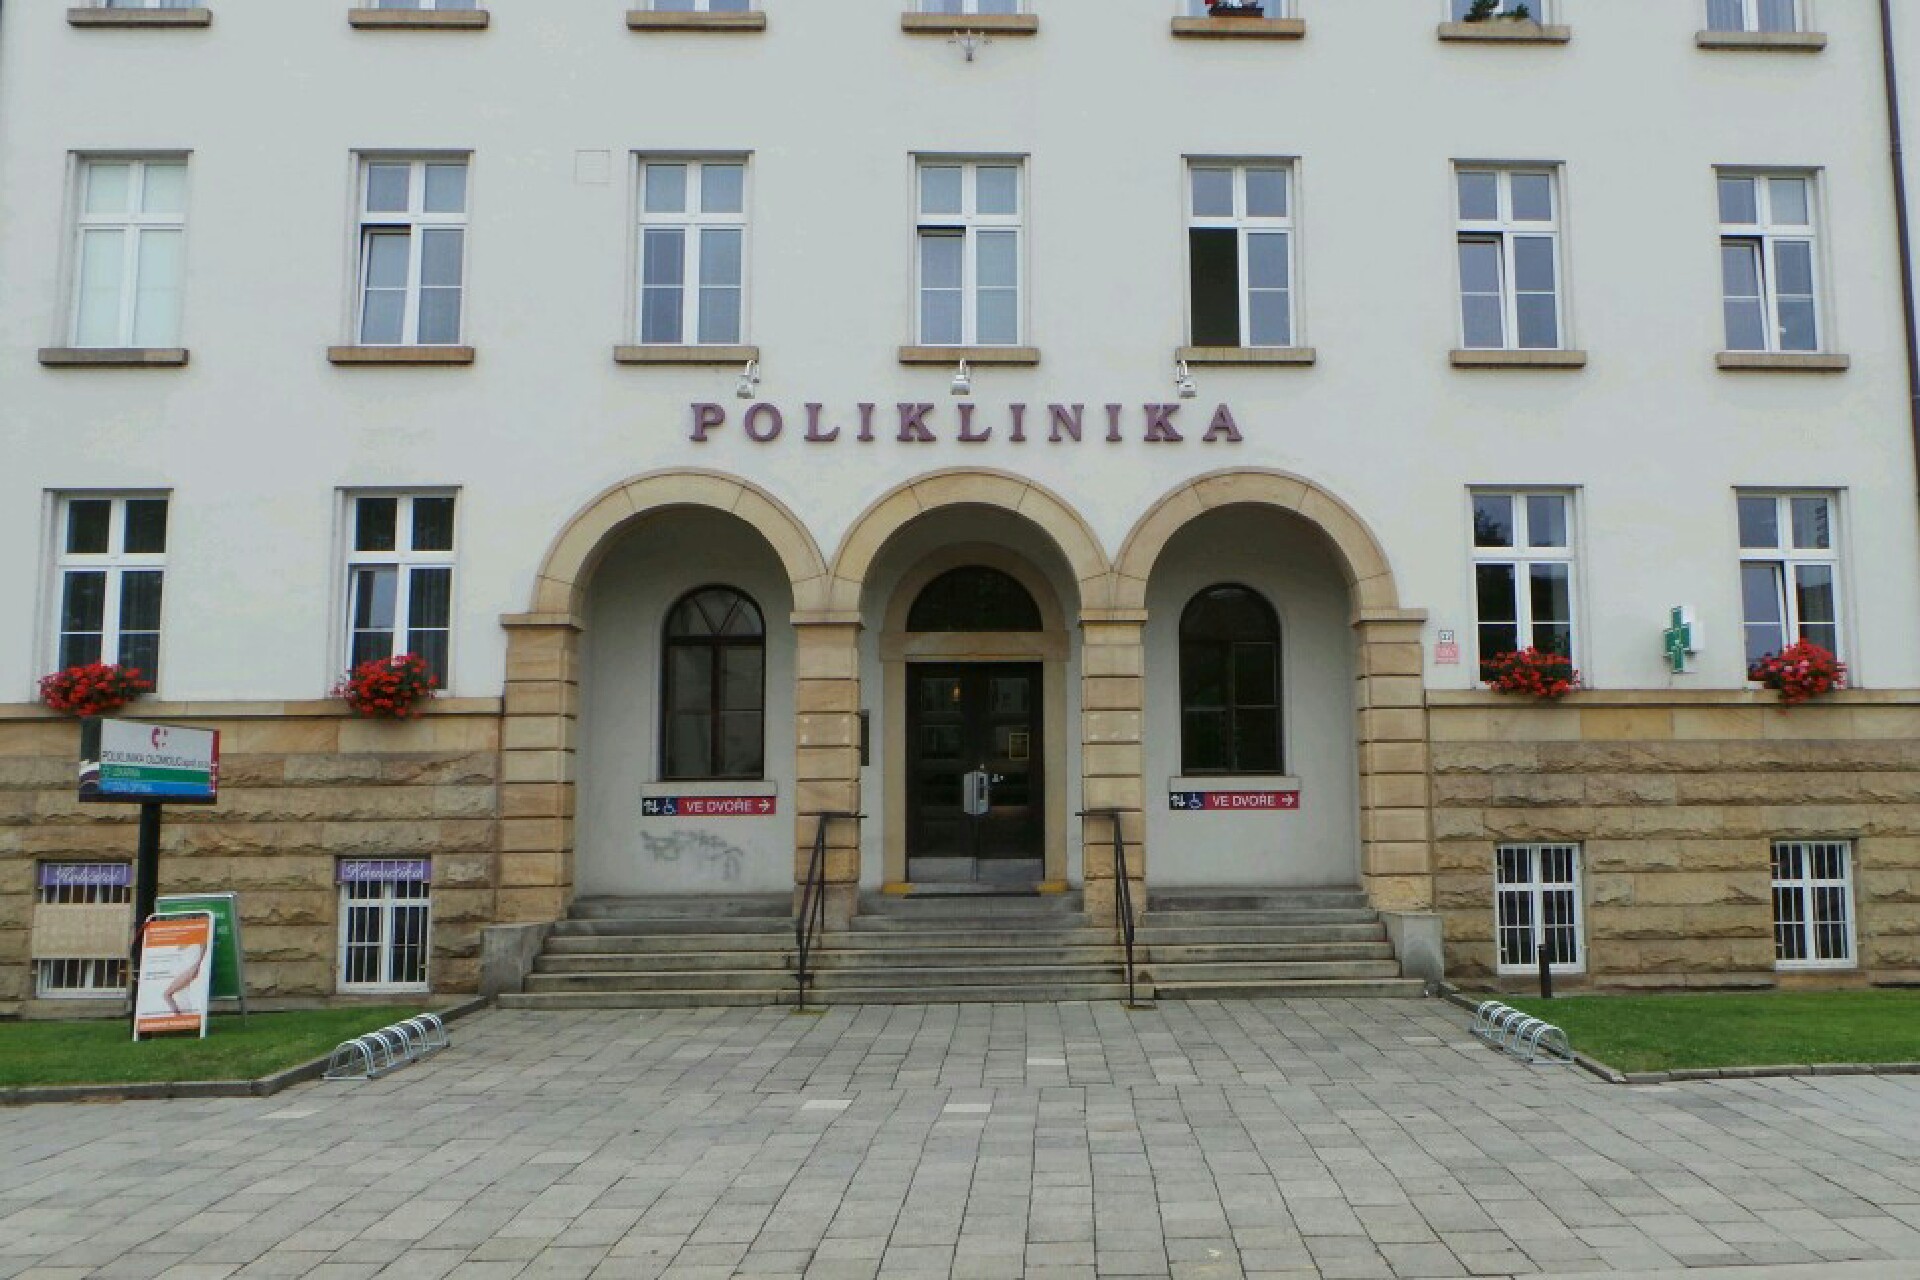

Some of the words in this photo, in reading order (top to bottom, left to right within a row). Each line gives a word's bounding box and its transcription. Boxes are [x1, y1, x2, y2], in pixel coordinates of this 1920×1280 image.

[688, 402, 1243, 442] POLIKLINIKA
[686, 801, 704, 813] VE
[706, 798, 752, 813] DVOŘE
[1212, 795, 1229, 806] VE
[1232, 792, 1276, 806] DVOŘE
